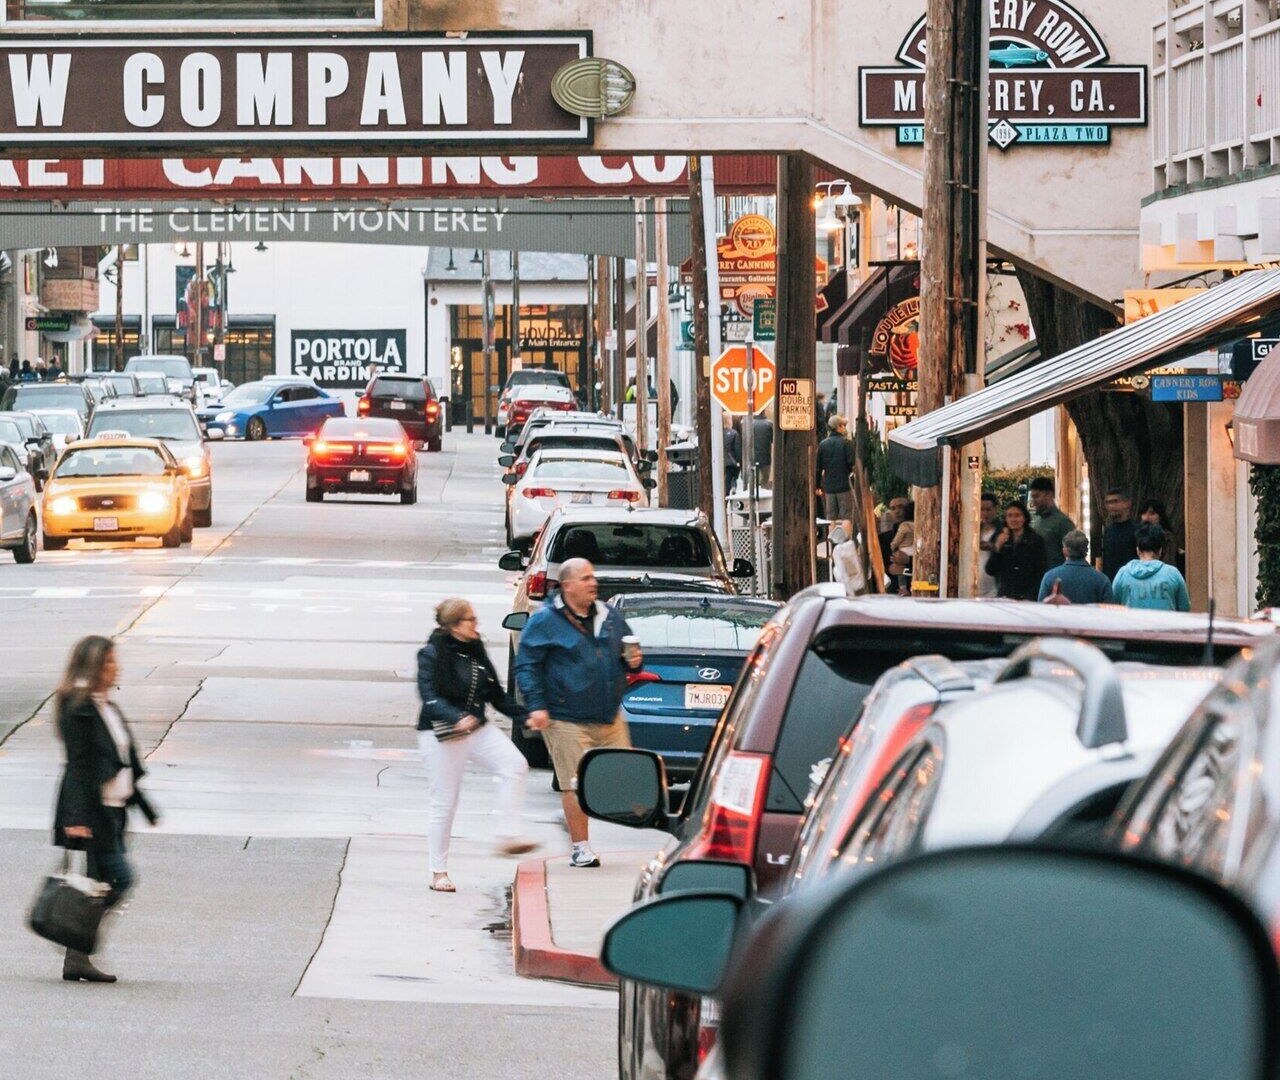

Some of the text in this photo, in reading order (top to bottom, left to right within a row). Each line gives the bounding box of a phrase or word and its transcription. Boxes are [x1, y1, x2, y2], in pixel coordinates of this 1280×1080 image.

[1034, 9, 1091, 63] ROW
[122, 50, 526, 127] COMPANY
[1070, 80, 1116, 112] CA.
[1027, 128, 1069, 140] PLAZA
[1076, 127, 1104, 140] TWO
[94, 207, 509, 232] THE CLEMENT MONTEREY
[737, 260, 775, 269] CANNING
[873, 307, 906, 354] LOUIE
[295, 338, 402, 366] PORTOLA
[716, 367, 773, 393] STOP
[868, 381, 898, 390] PASTA
[1153, 378, 1218, 388] CANNERY ROW
[783, 383, 795, 393] NO
[1176, 390, 1198, 399] KIDS
[782, 397, 812, 405] DOUBLE
[782, 406, 811, 414] PARKING
